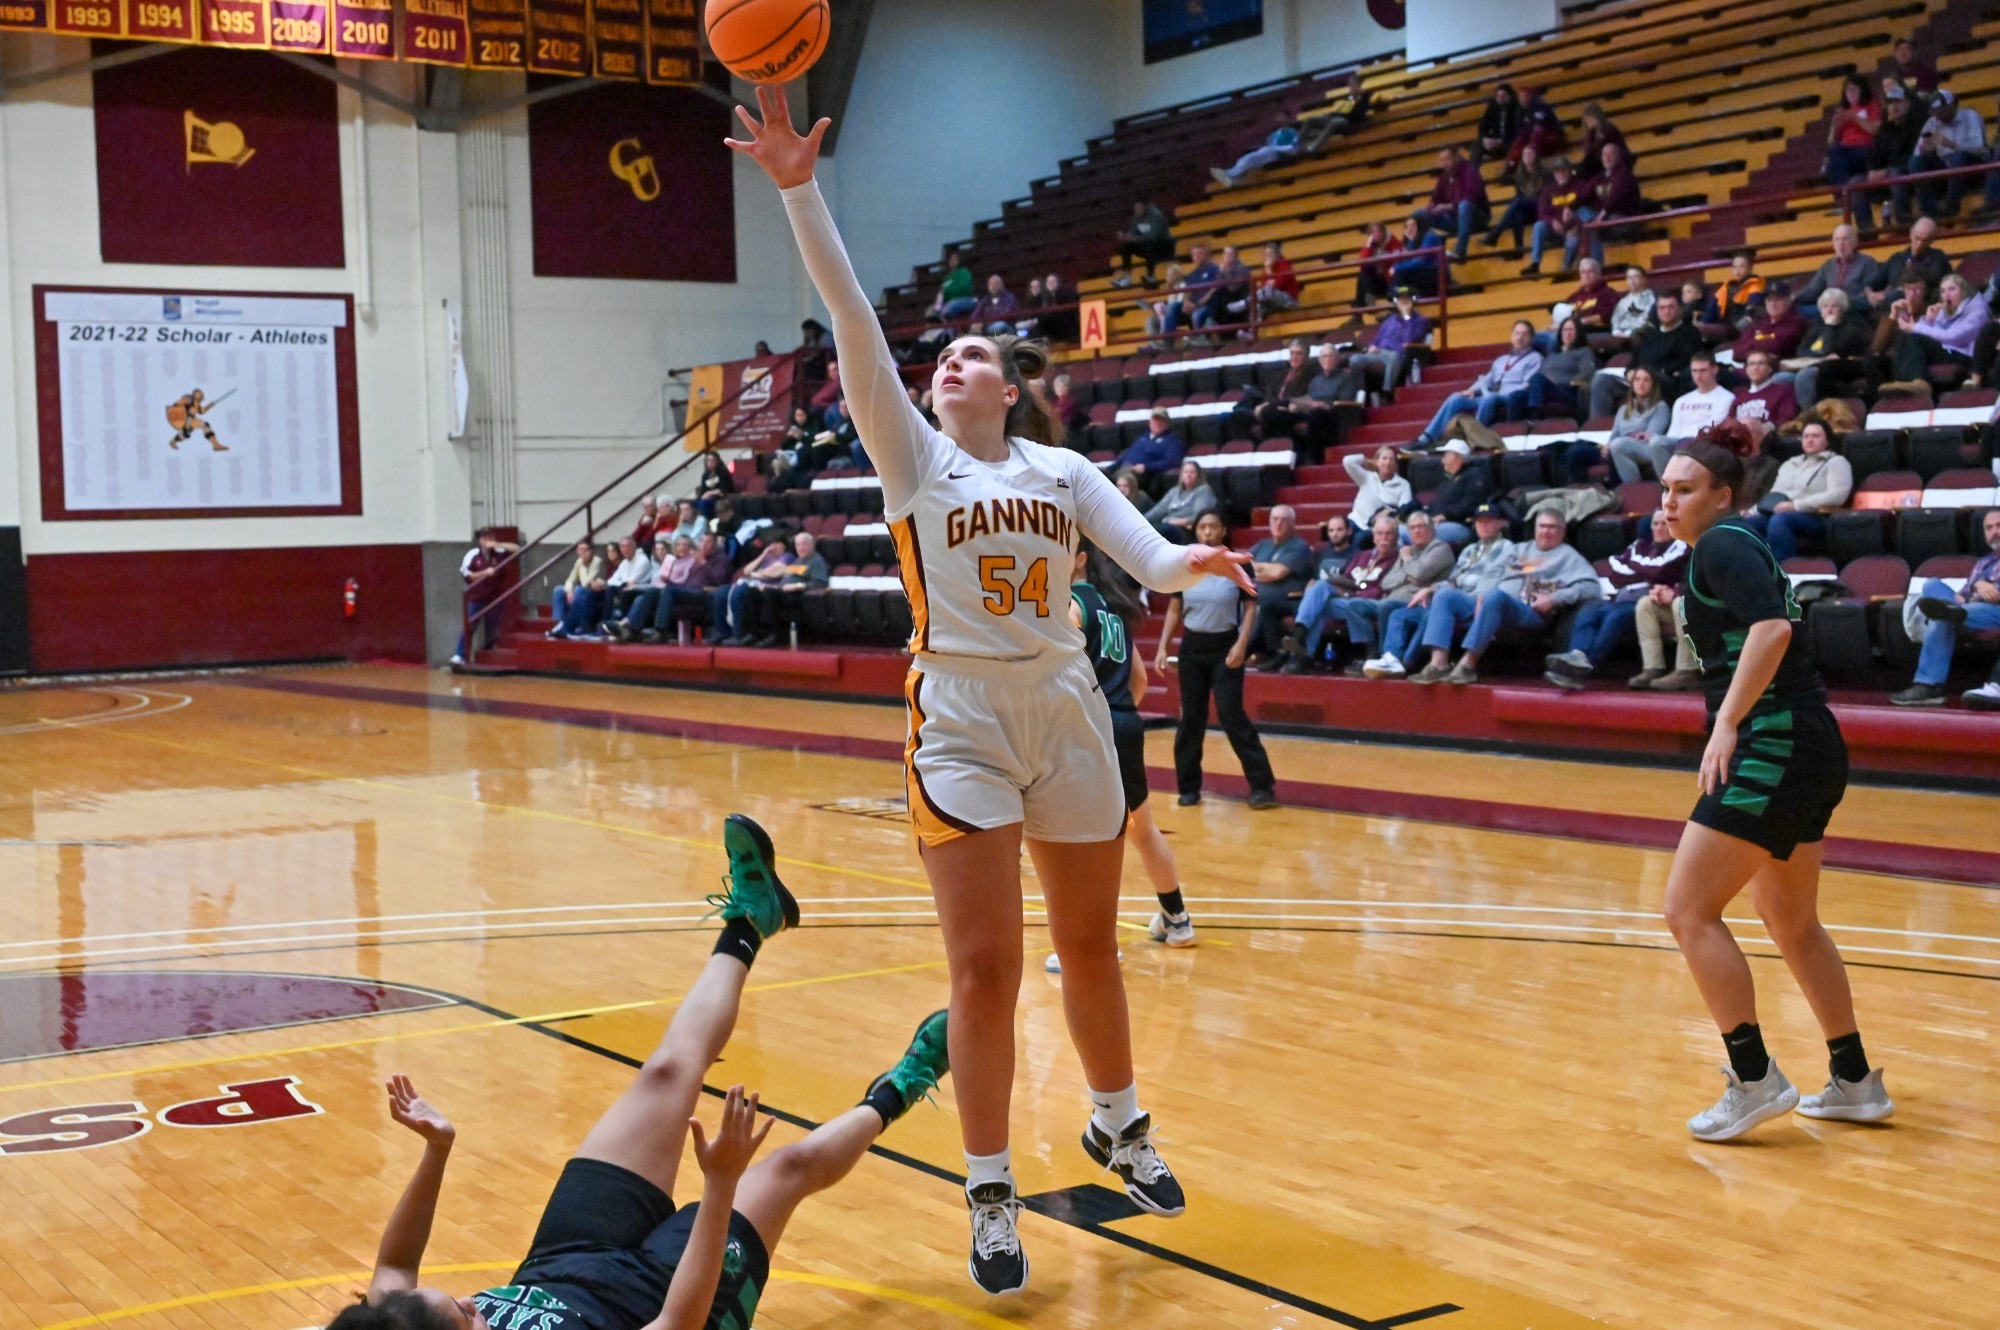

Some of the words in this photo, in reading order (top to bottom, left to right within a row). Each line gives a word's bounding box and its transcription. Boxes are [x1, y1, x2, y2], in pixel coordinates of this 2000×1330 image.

[66, 6, 112, 27] 1993
[138, 3, 184, 29] 1994
[210, 8, 256, 35] 1995
[272, 17, 322, 44] 2009
[342, 19, 389, 45] 2010
[414, 25, 457, 51] 2011
[481, 40, 520, 63] 2012
[537, 38, 580, 63] 2012
[68, 325, 149, 343] 2021-22
[156, 327, 234, 344] Scholar
[250, 328, 329, 346] Athletes
[1084, 307, 1103, 343] A
[947, 498, 1072, 555] GANNON
[978, 555, 1050, 618] 54
[1096, 609, 1127, 664] 10
